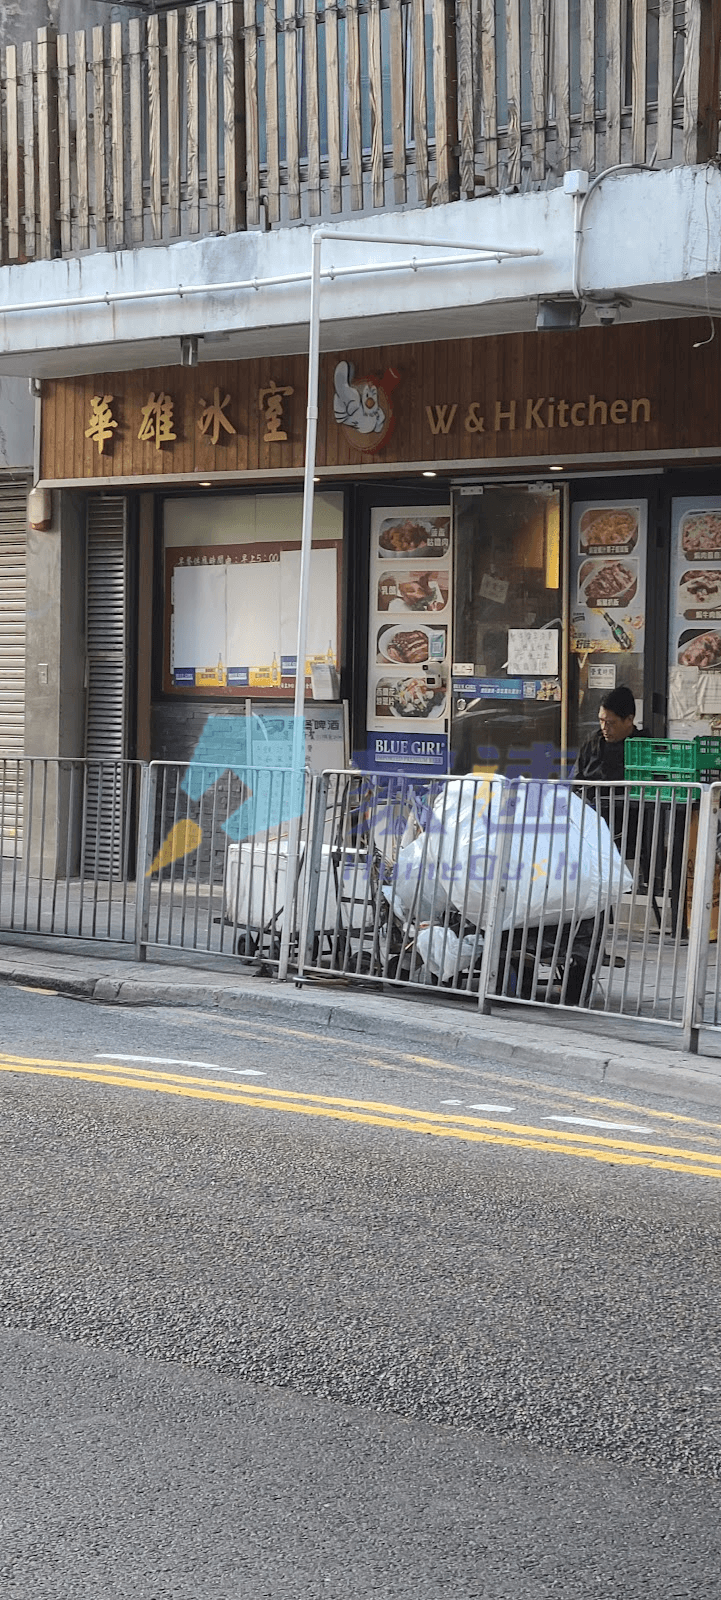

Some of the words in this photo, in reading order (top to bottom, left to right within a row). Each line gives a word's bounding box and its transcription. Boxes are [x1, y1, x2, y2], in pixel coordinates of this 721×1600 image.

[84, 380, 294, 454] 華雄冰室
[425, 403, 457, 435] W
[464, 401, 485, 433] &
[494, 400, 516, 432] H
[525, 395, 651, 430] Kitchen
[375, 739, 409, 754] BLUE
[411, 741, 443, 756] GIRL
